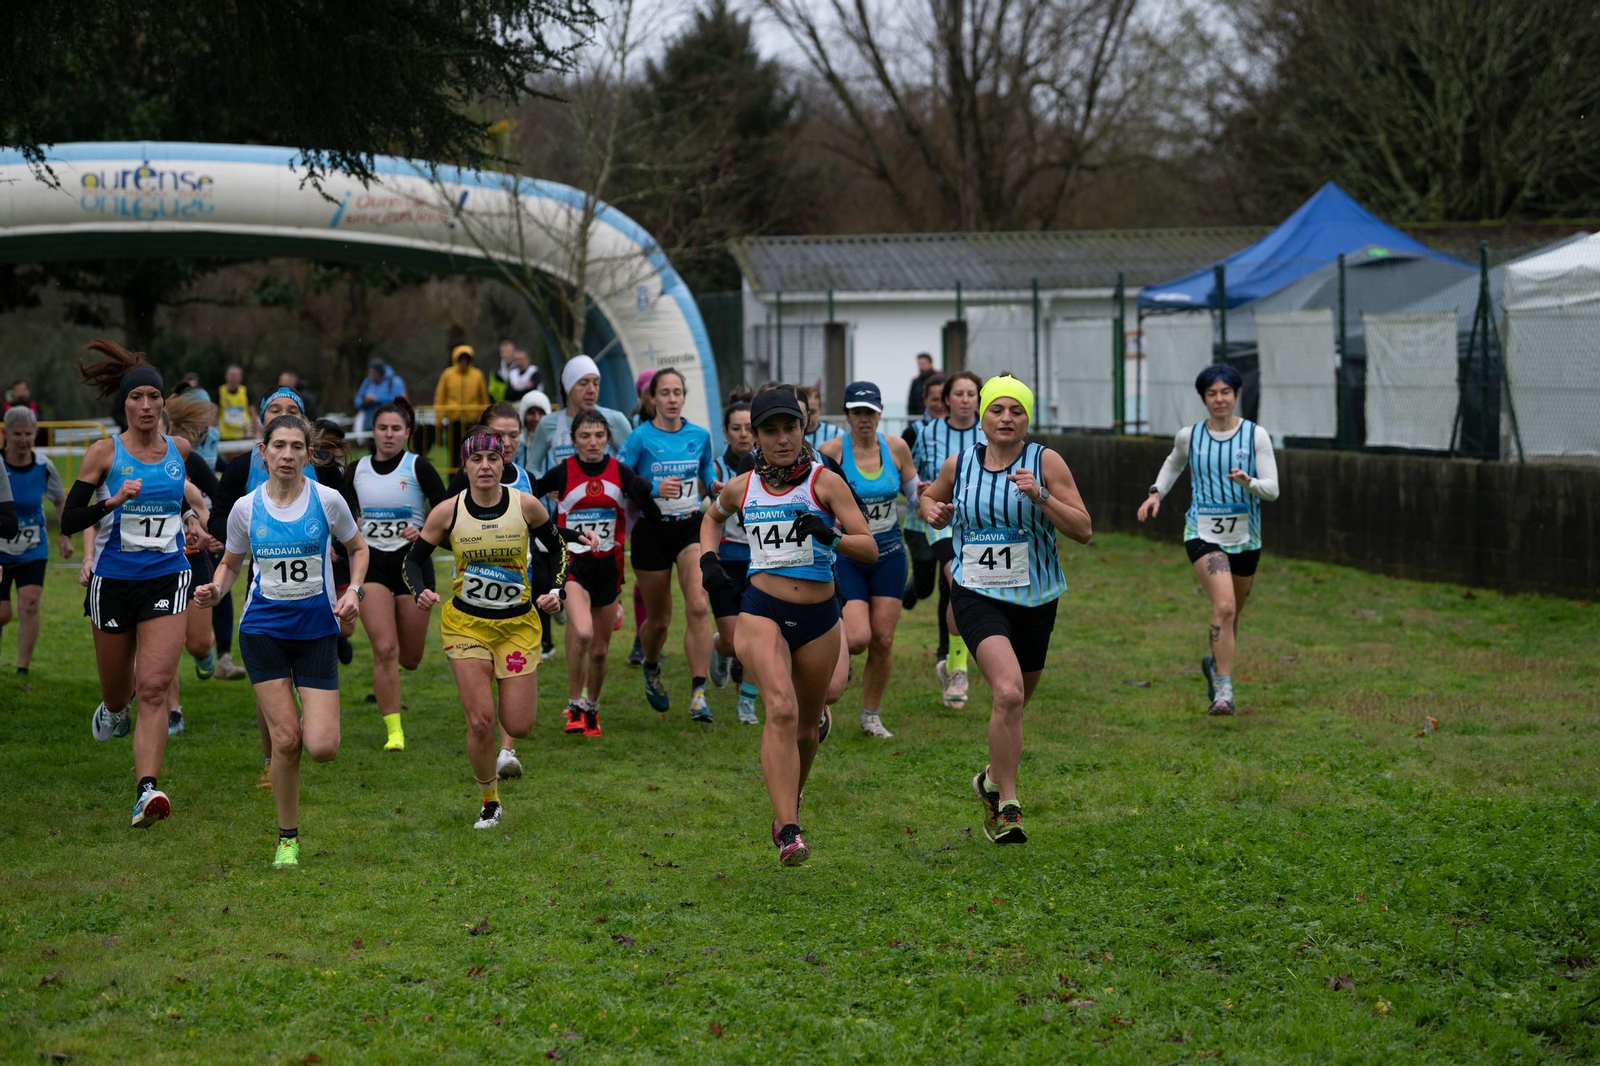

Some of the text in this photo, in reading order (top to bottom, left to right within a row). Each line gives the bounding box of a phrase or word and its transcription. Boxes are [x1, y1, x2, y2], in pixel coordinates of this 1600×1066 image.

[123, 505, 163, 513] RIBADAVIA
[745, 511, 786, 520] RIBADAVIA
[870, 502, 892, 520] 47
[139, 517, 167, 538] 17
[367, 521, 408, 538] 238
[1211, 517, 1238, 534] 37
[752, 525, 806, 550] 144
[964, 533, 1005, 542] RIBADAVIA
[256, 547, 302, 556] RIBADAVIA
[462, 547, 521, 559] ATHLETICS
[979, 547, 1011, 570] 41
[273, 559, 308, 583] 18
[466, 564, 507, 580] RIBADAVIA
[466, 578, 521, 603] 209
